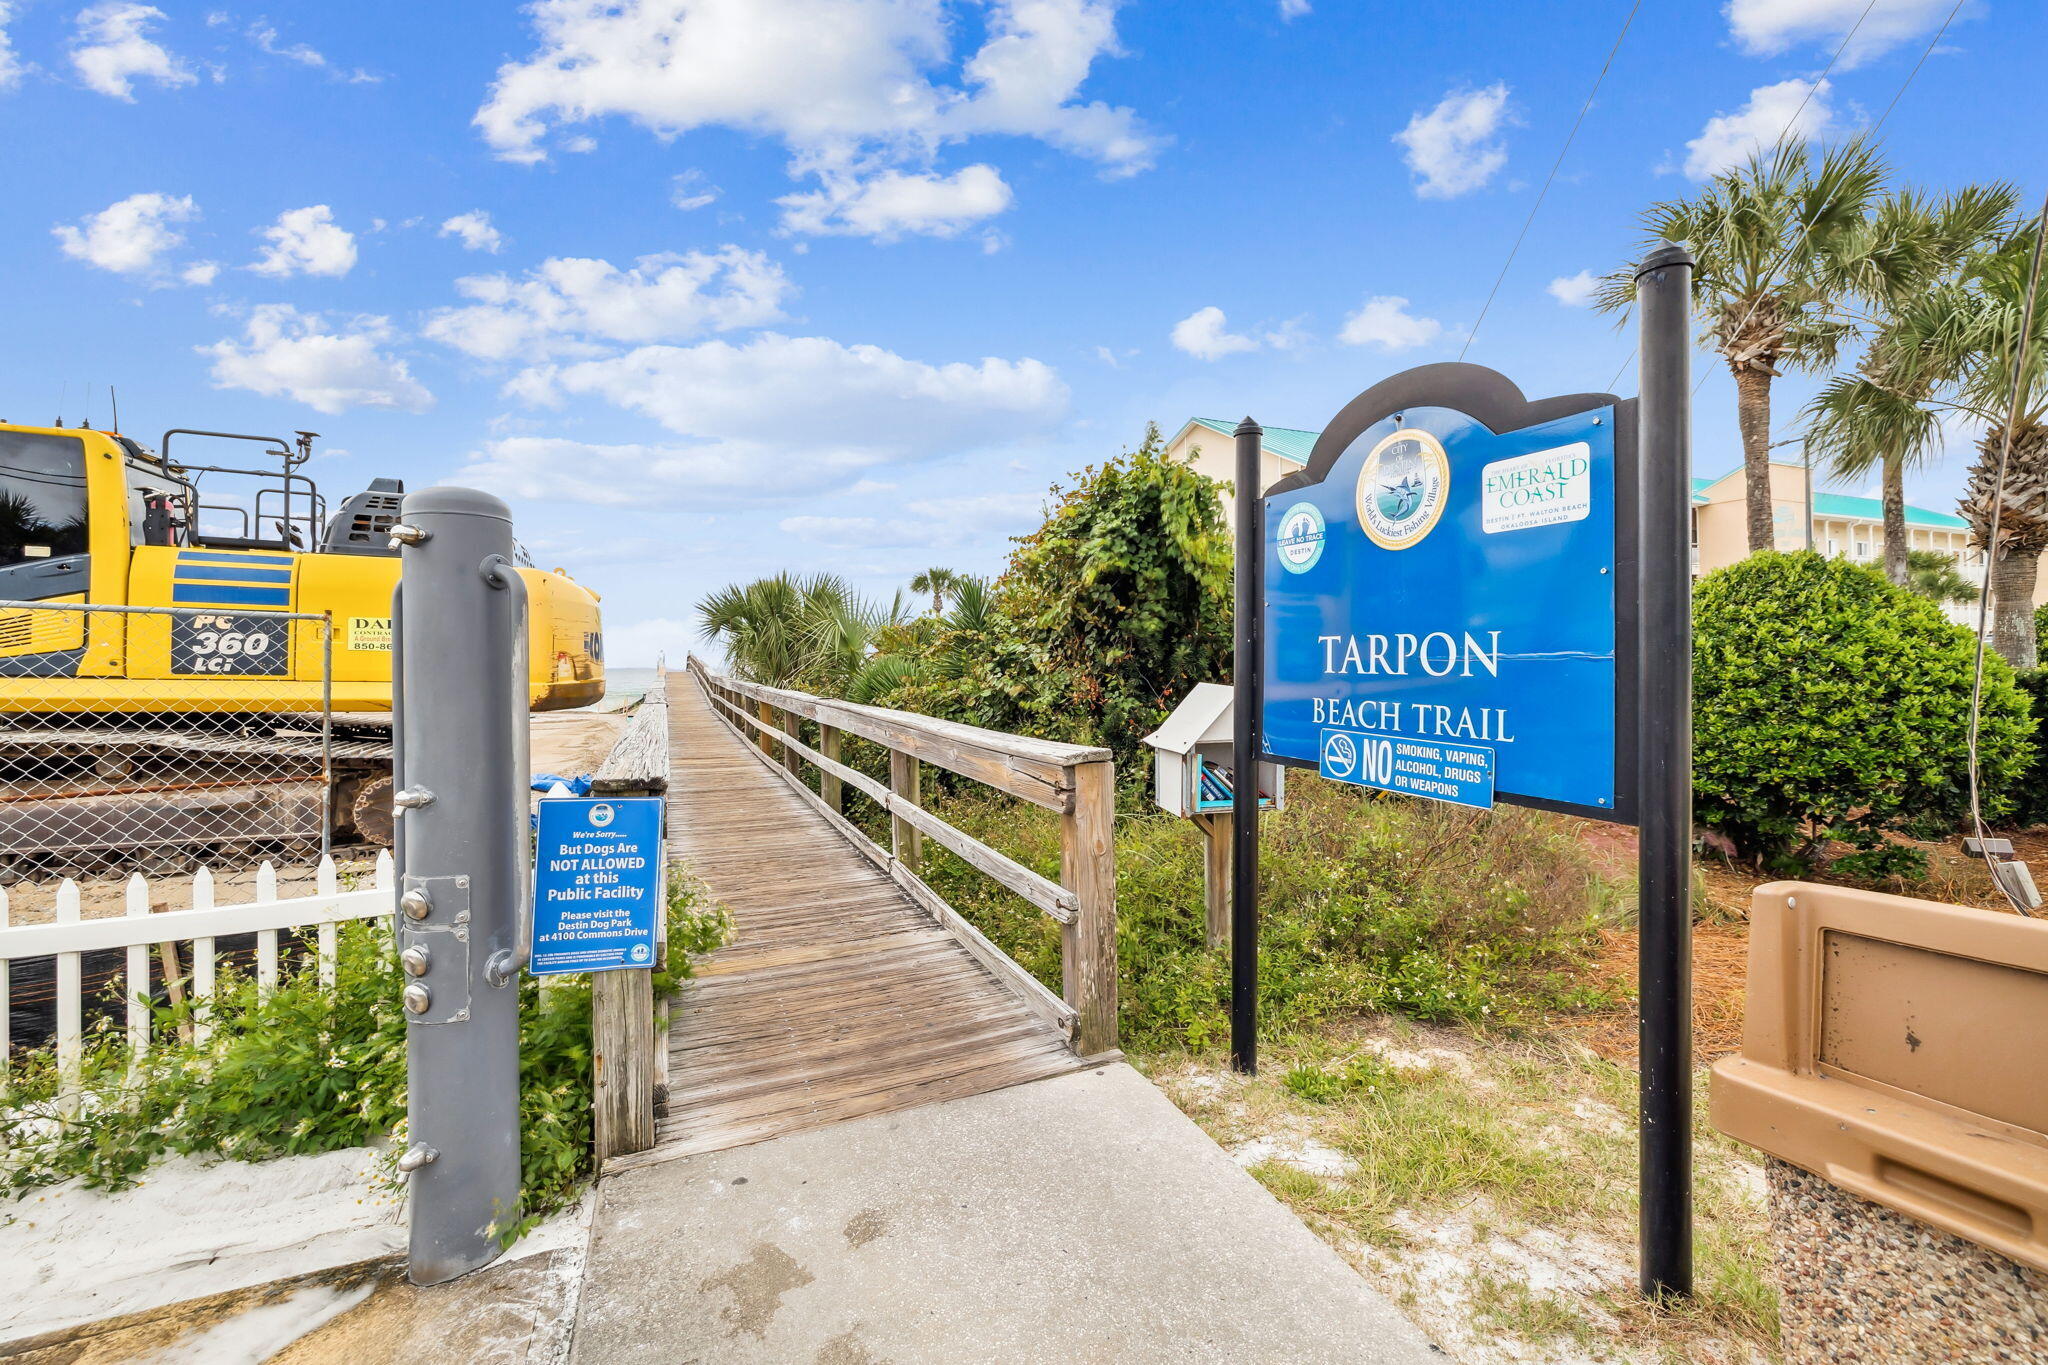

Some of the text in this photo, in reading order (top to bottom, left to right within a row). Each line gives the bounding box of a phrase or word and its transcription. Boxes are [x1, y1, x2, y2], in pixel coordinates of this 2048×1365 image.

[1392, 443, 1408, 454] CITY
[1486, 458, 1588, 493] EMERALD
[1500, 482, 1568, 508] COAST
[1365, 476, 1440, 536] World's Luckiest Fishing Village
[1530, 508, 1559, 517] WALTON
[1562, 503, 1588, 511] BEACH
[1501, 515, 1568, 530] OKALOOSA ISLAND
[193, 615, 234, 630] PC
[192, 631, 270, 656] 360
[1318, 630, 1502, 678] TARPON
[1312, 697, 1515, 743] BEACH TRAIL
[1362, 738, 1393, 785] NO
[1396, 743, 1488, 769] SMOKING, VAPING,
[1395, 759, 1481, 784] ALCOHOL, DRUGS
[1395, 775, 1459, 797] OR WEAPONS
[572, 831, 595, 839] We're
[559, 843, 638, 857] But Dogs Are
[550, 857, 645, 872] NOT ALLOWED
[575, 872, 619, 885] at this
[548, 886, 645, 901] Public Facility
[561, 909, 631, 920] Please visit the
[558, 918, 632, 931] Destin Dog Park
[539, 928, 649, 942] at 4100 Commons Drive
